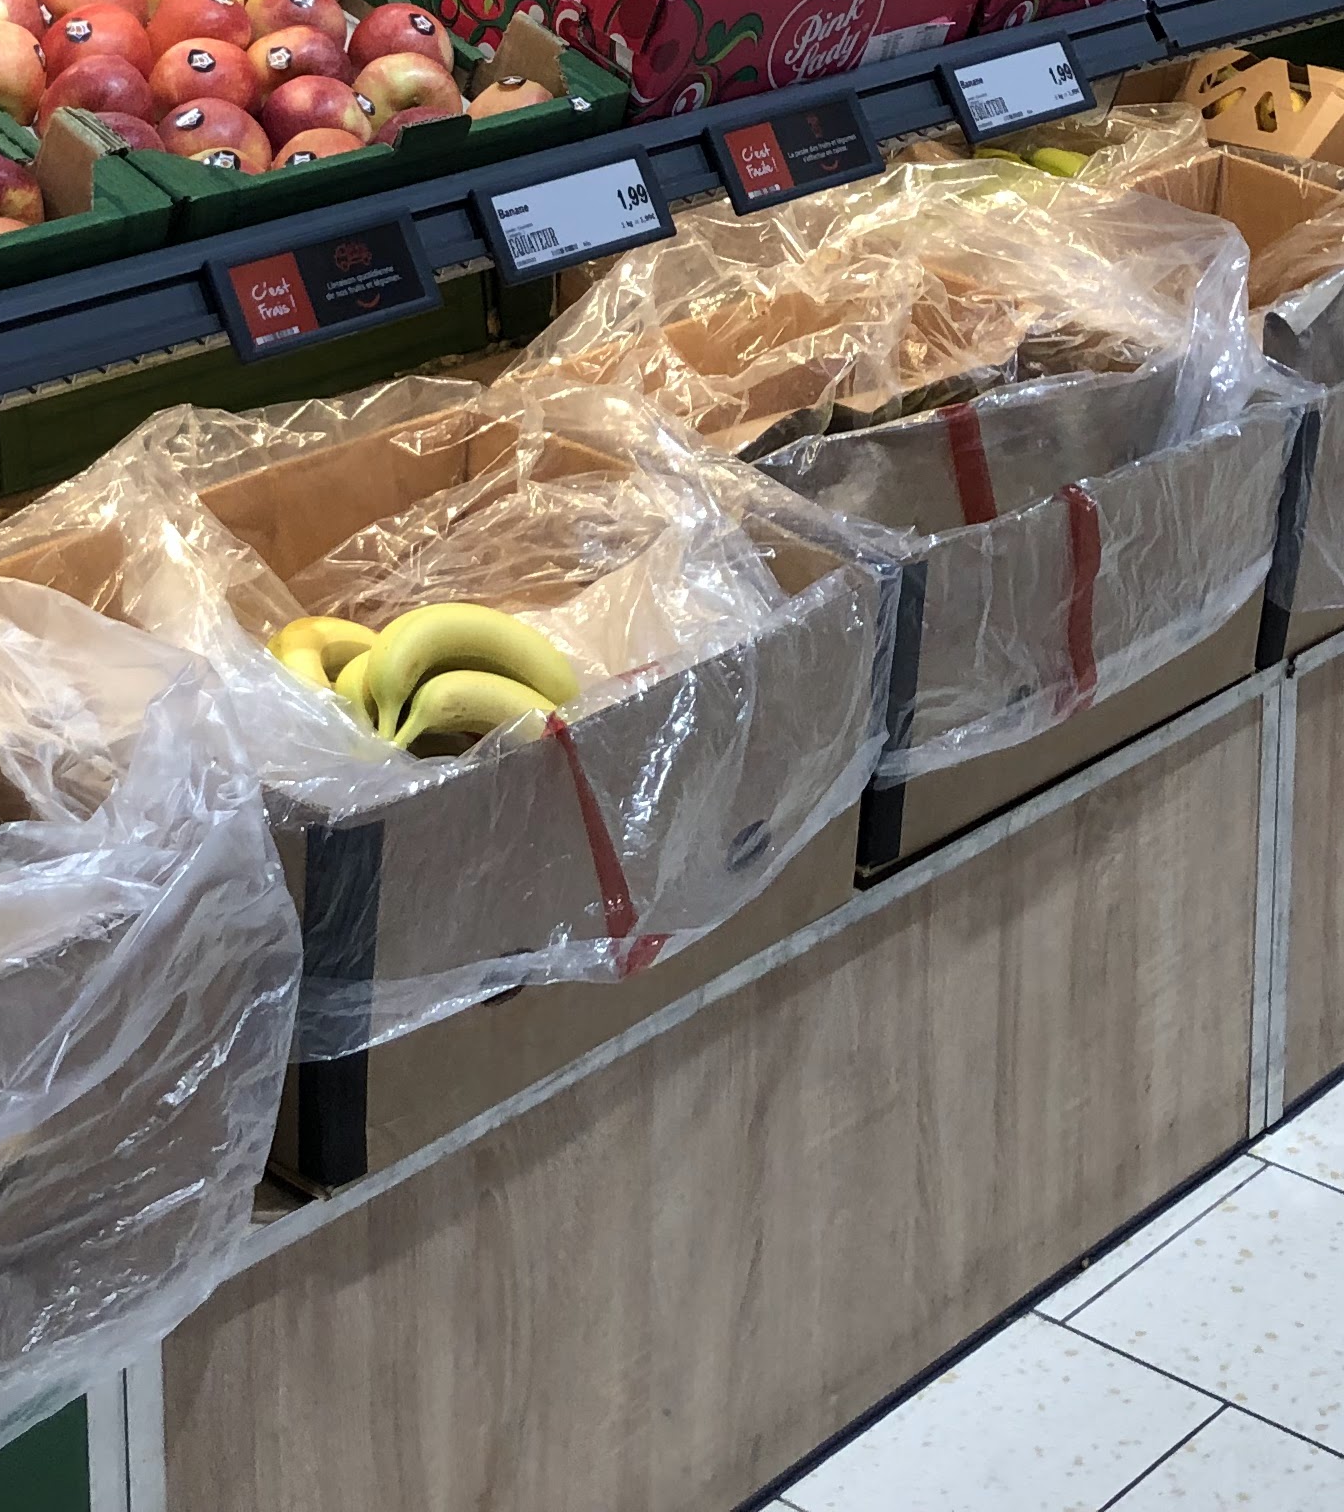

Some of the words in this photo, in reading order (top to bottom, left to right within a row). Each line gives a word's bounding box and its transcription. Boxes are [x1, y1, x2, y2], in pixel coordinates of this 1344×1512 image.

[787, 26, 862, 85] Lady
[960, 77, 984, 90] Banane
[1048, 63, 1074, 86] 1,99
[741, 141, 771, 162] C'est
[617, 184, 649, 211] 1,99
[498, 204, 530, 220] Banane
[508, 226, 560, 258] EQUATEUR
[251, 277, 291, 302] C'est
